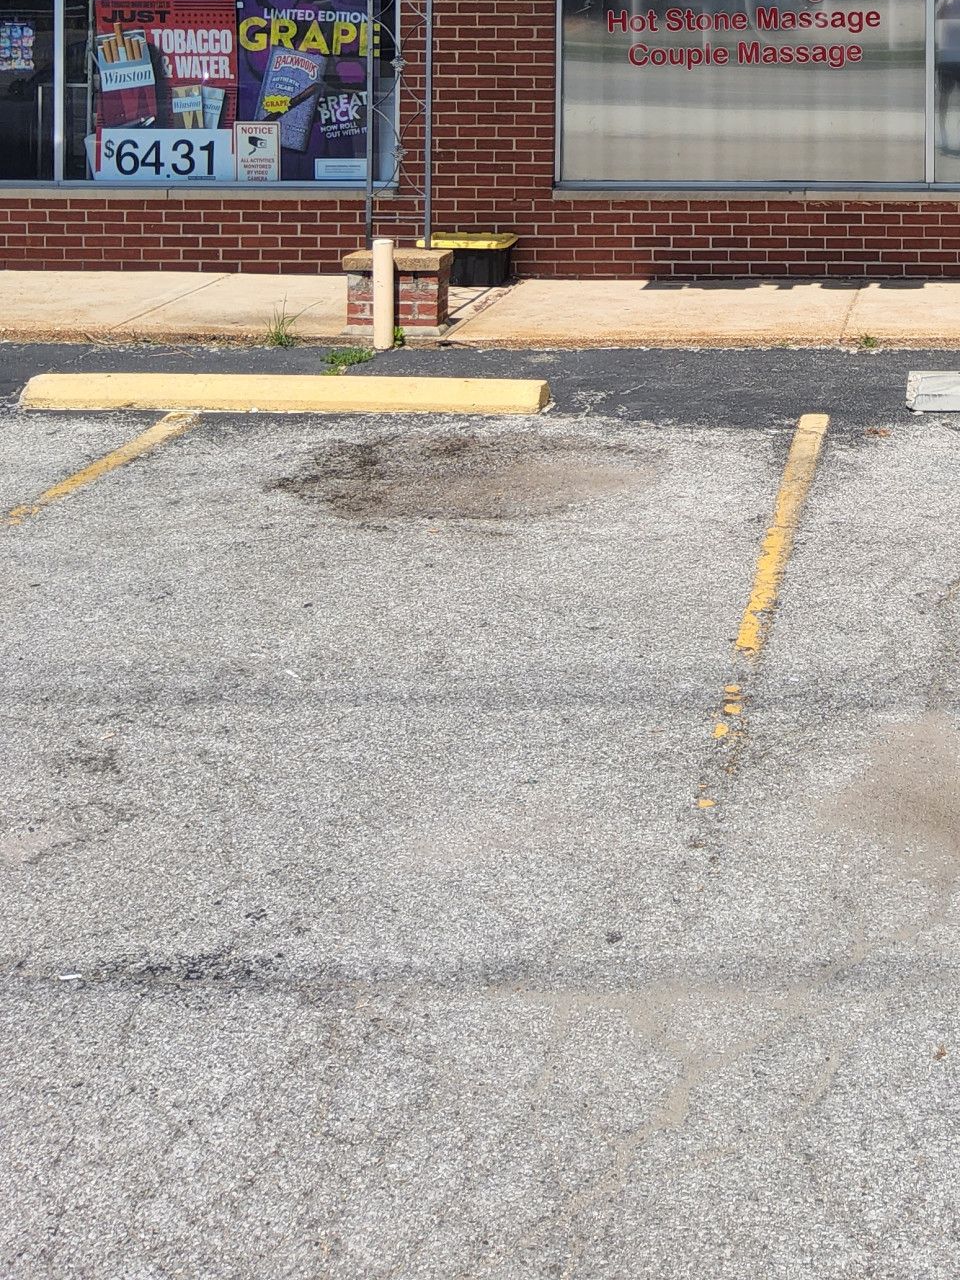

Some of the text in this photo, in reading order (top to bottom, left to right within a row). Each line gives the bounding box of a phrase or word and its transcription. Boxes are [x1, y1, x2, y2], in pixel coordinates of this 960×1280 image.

[102, 9, 171, 24] JUST
[263, 7, 315, 21] LIMITED
[607, 6, 881, 34] Hot Stone Massage
[151, 28, 233, 54] TOBACCO
[239, 16, 381, 58] GRAPE
[628, 40, 863, 70] Couple Massage
[104, 69, 152, 85] Winston
[162, 55, 235, 80] & WATER.
[273, 54, 319, 80] BACKWOODS
[318, 91, 368, 111] GREAT
[319, 105, 361, 124] PICK
[241, 126, 273, 135] NOTICE
[320, 121, 358, 133] NOW ROLL
[325, 131, 341, 139] OUT
[342, 128, 360, 136] WITH
[104, 138, 215, 179] $64.31
